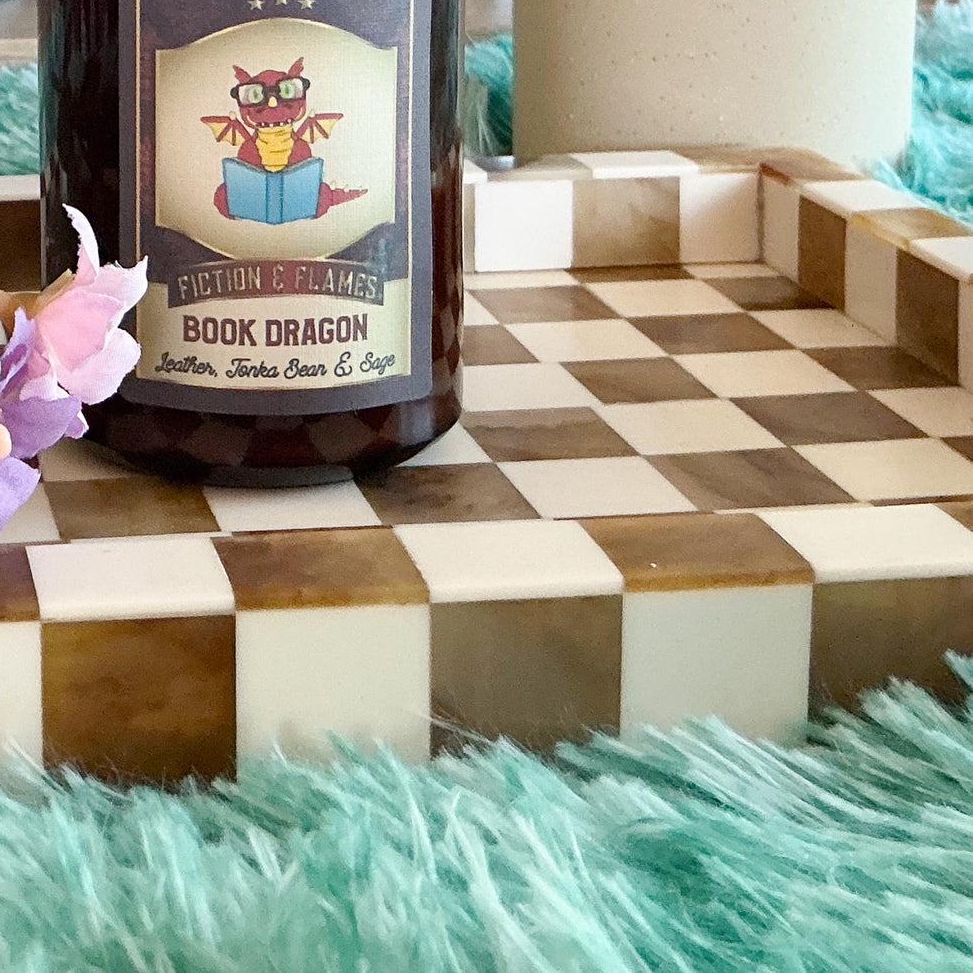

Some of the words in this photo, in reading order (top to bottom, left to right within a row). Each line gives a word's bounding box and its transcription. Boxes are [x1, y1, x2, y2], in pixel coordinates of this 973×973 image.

[178, 266, 262, 300] FICTION
[272, 264, 284, 292] &
[295, 266, 379, 299] FLAMES
[182, 314, 257, 346] BOOK
[265, 313, 369, 347] DRAGON
[155, 351, 218, 377] Leather,
[226, 358, 280, 378] Tonka
[283, 358, 327, 379] Bean
[334, 352, 353, 377] &
[359, 352, 396, 375] Sage
